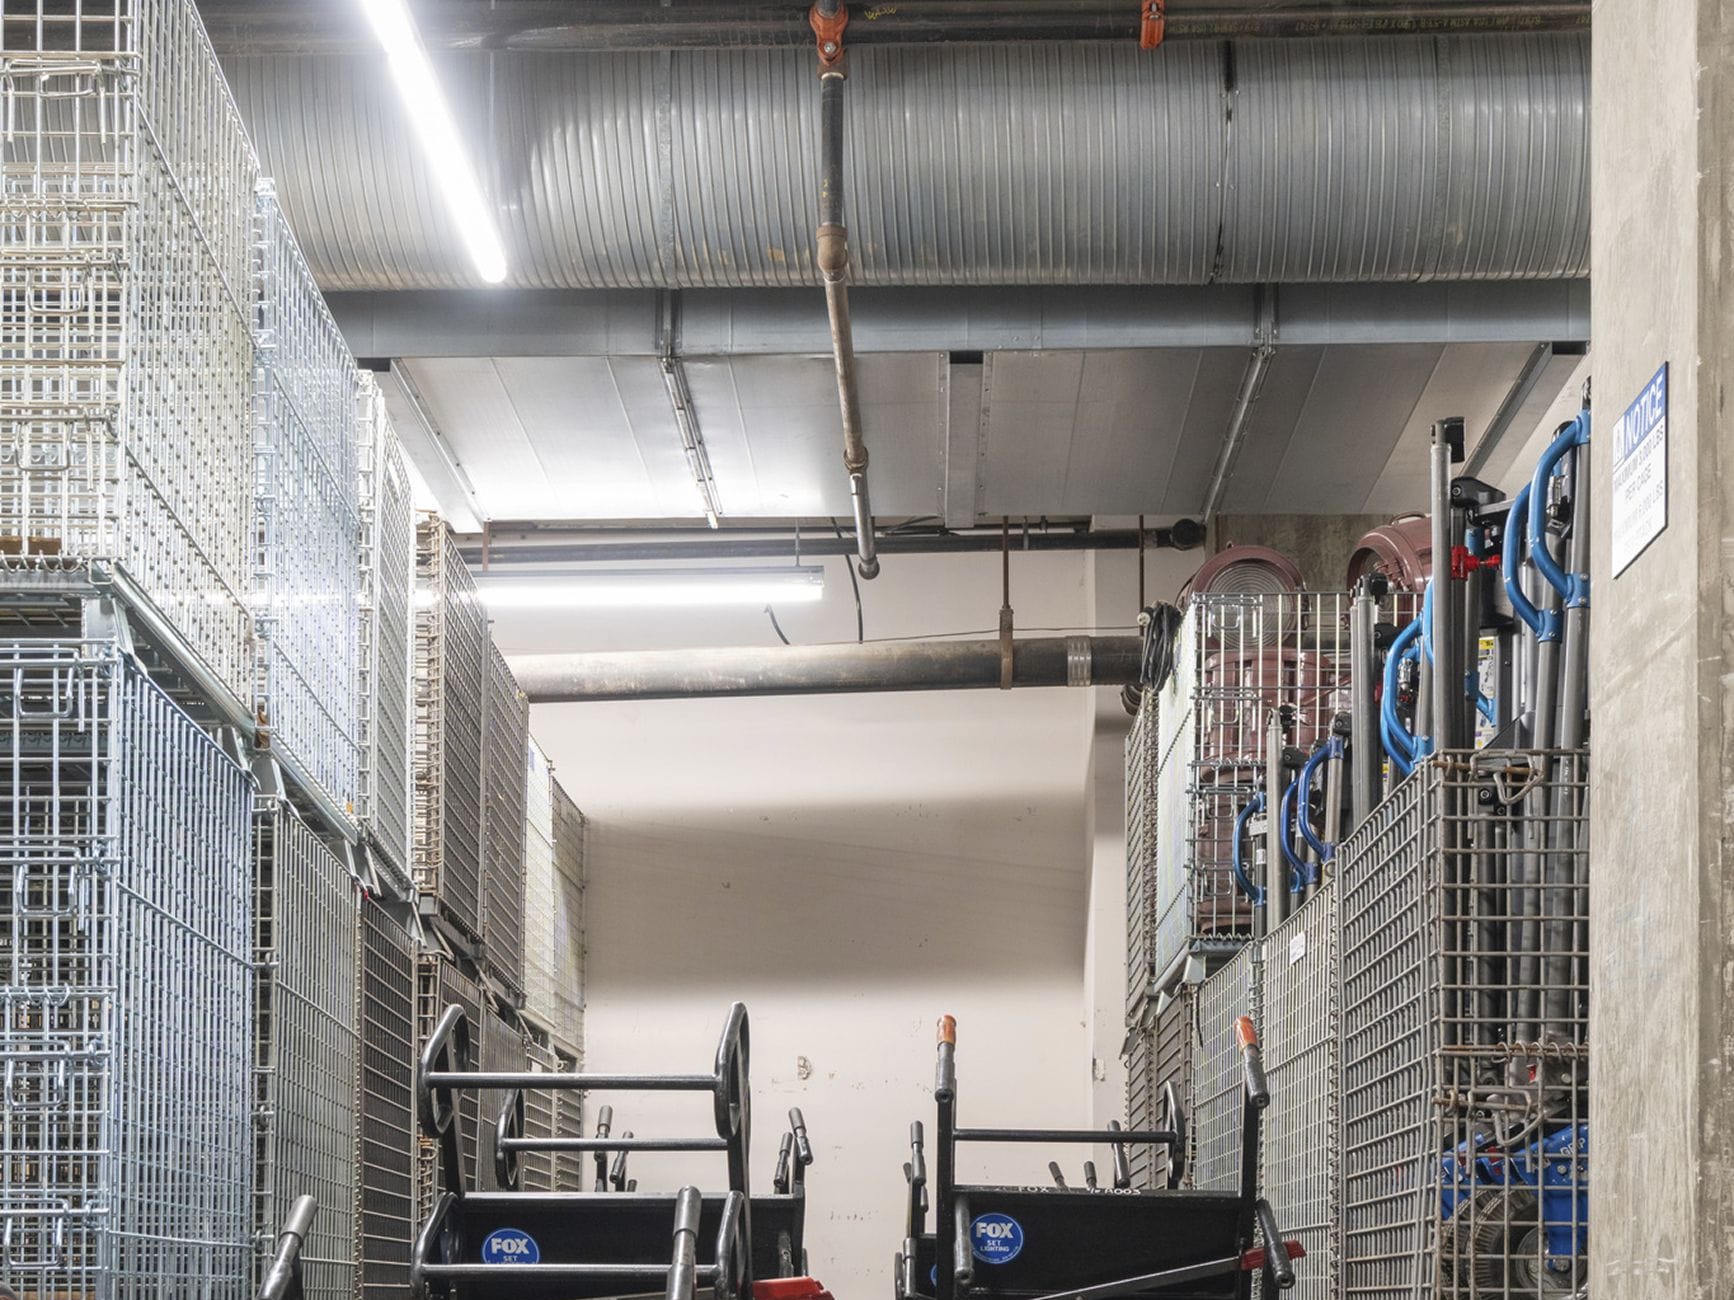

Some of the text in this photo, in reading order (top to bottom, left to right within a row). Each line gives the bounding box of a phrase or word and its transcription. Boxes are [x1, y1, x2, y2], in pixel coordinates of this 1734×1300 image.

[1624, 373, 1663, 456] NOTICE
[976, 1222, 1014, 1238] FOX
[491, 1238, 530, 1254] FOX
